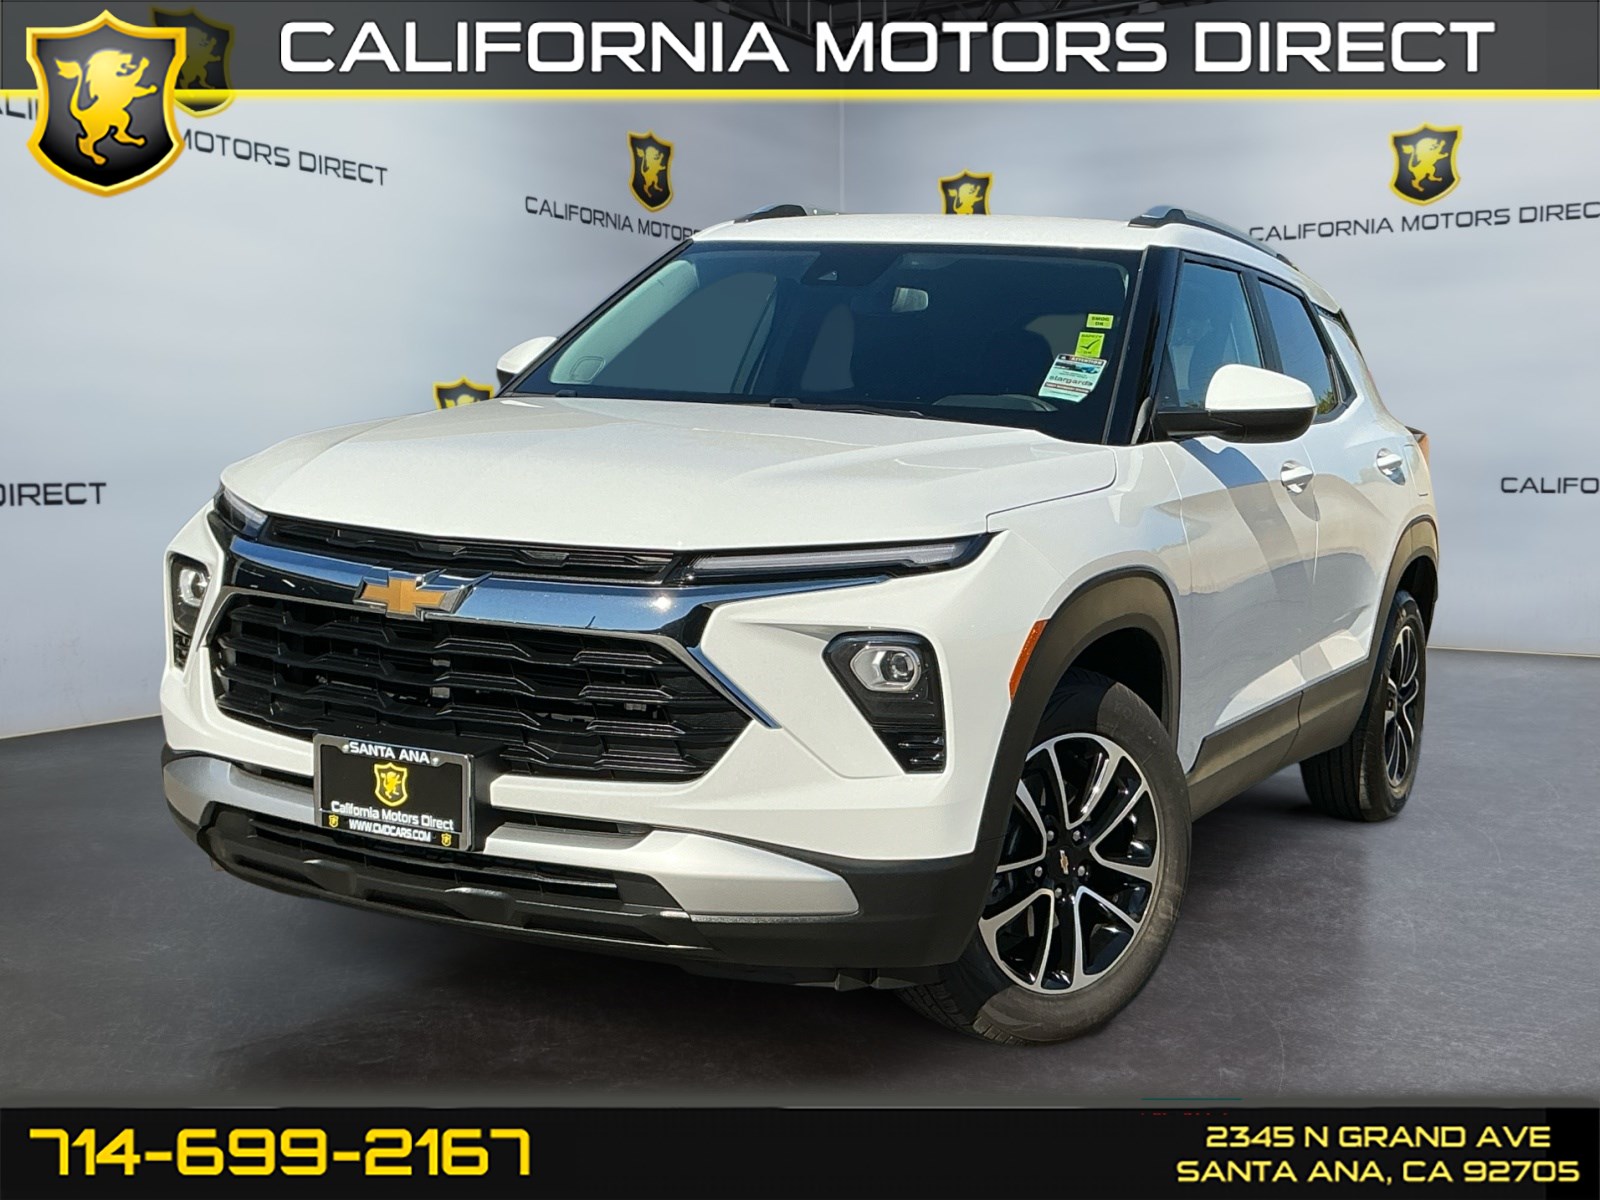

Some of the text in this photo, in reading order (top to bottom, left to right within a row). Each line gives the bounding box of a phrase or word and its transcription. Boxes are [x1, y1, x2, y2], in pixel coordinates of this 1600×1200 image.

[298, 150, 389, 186] DIRECT
[525, 195, 634, 233] CALIFORNIA
[1249, 217, 1394, 242] CALIFORNIA
[1401, 208, 1511, 233] MOTORS
[349, 741, 430, 764] SANTA ANA
[331, 800, 454, 831] California Motors Direct
